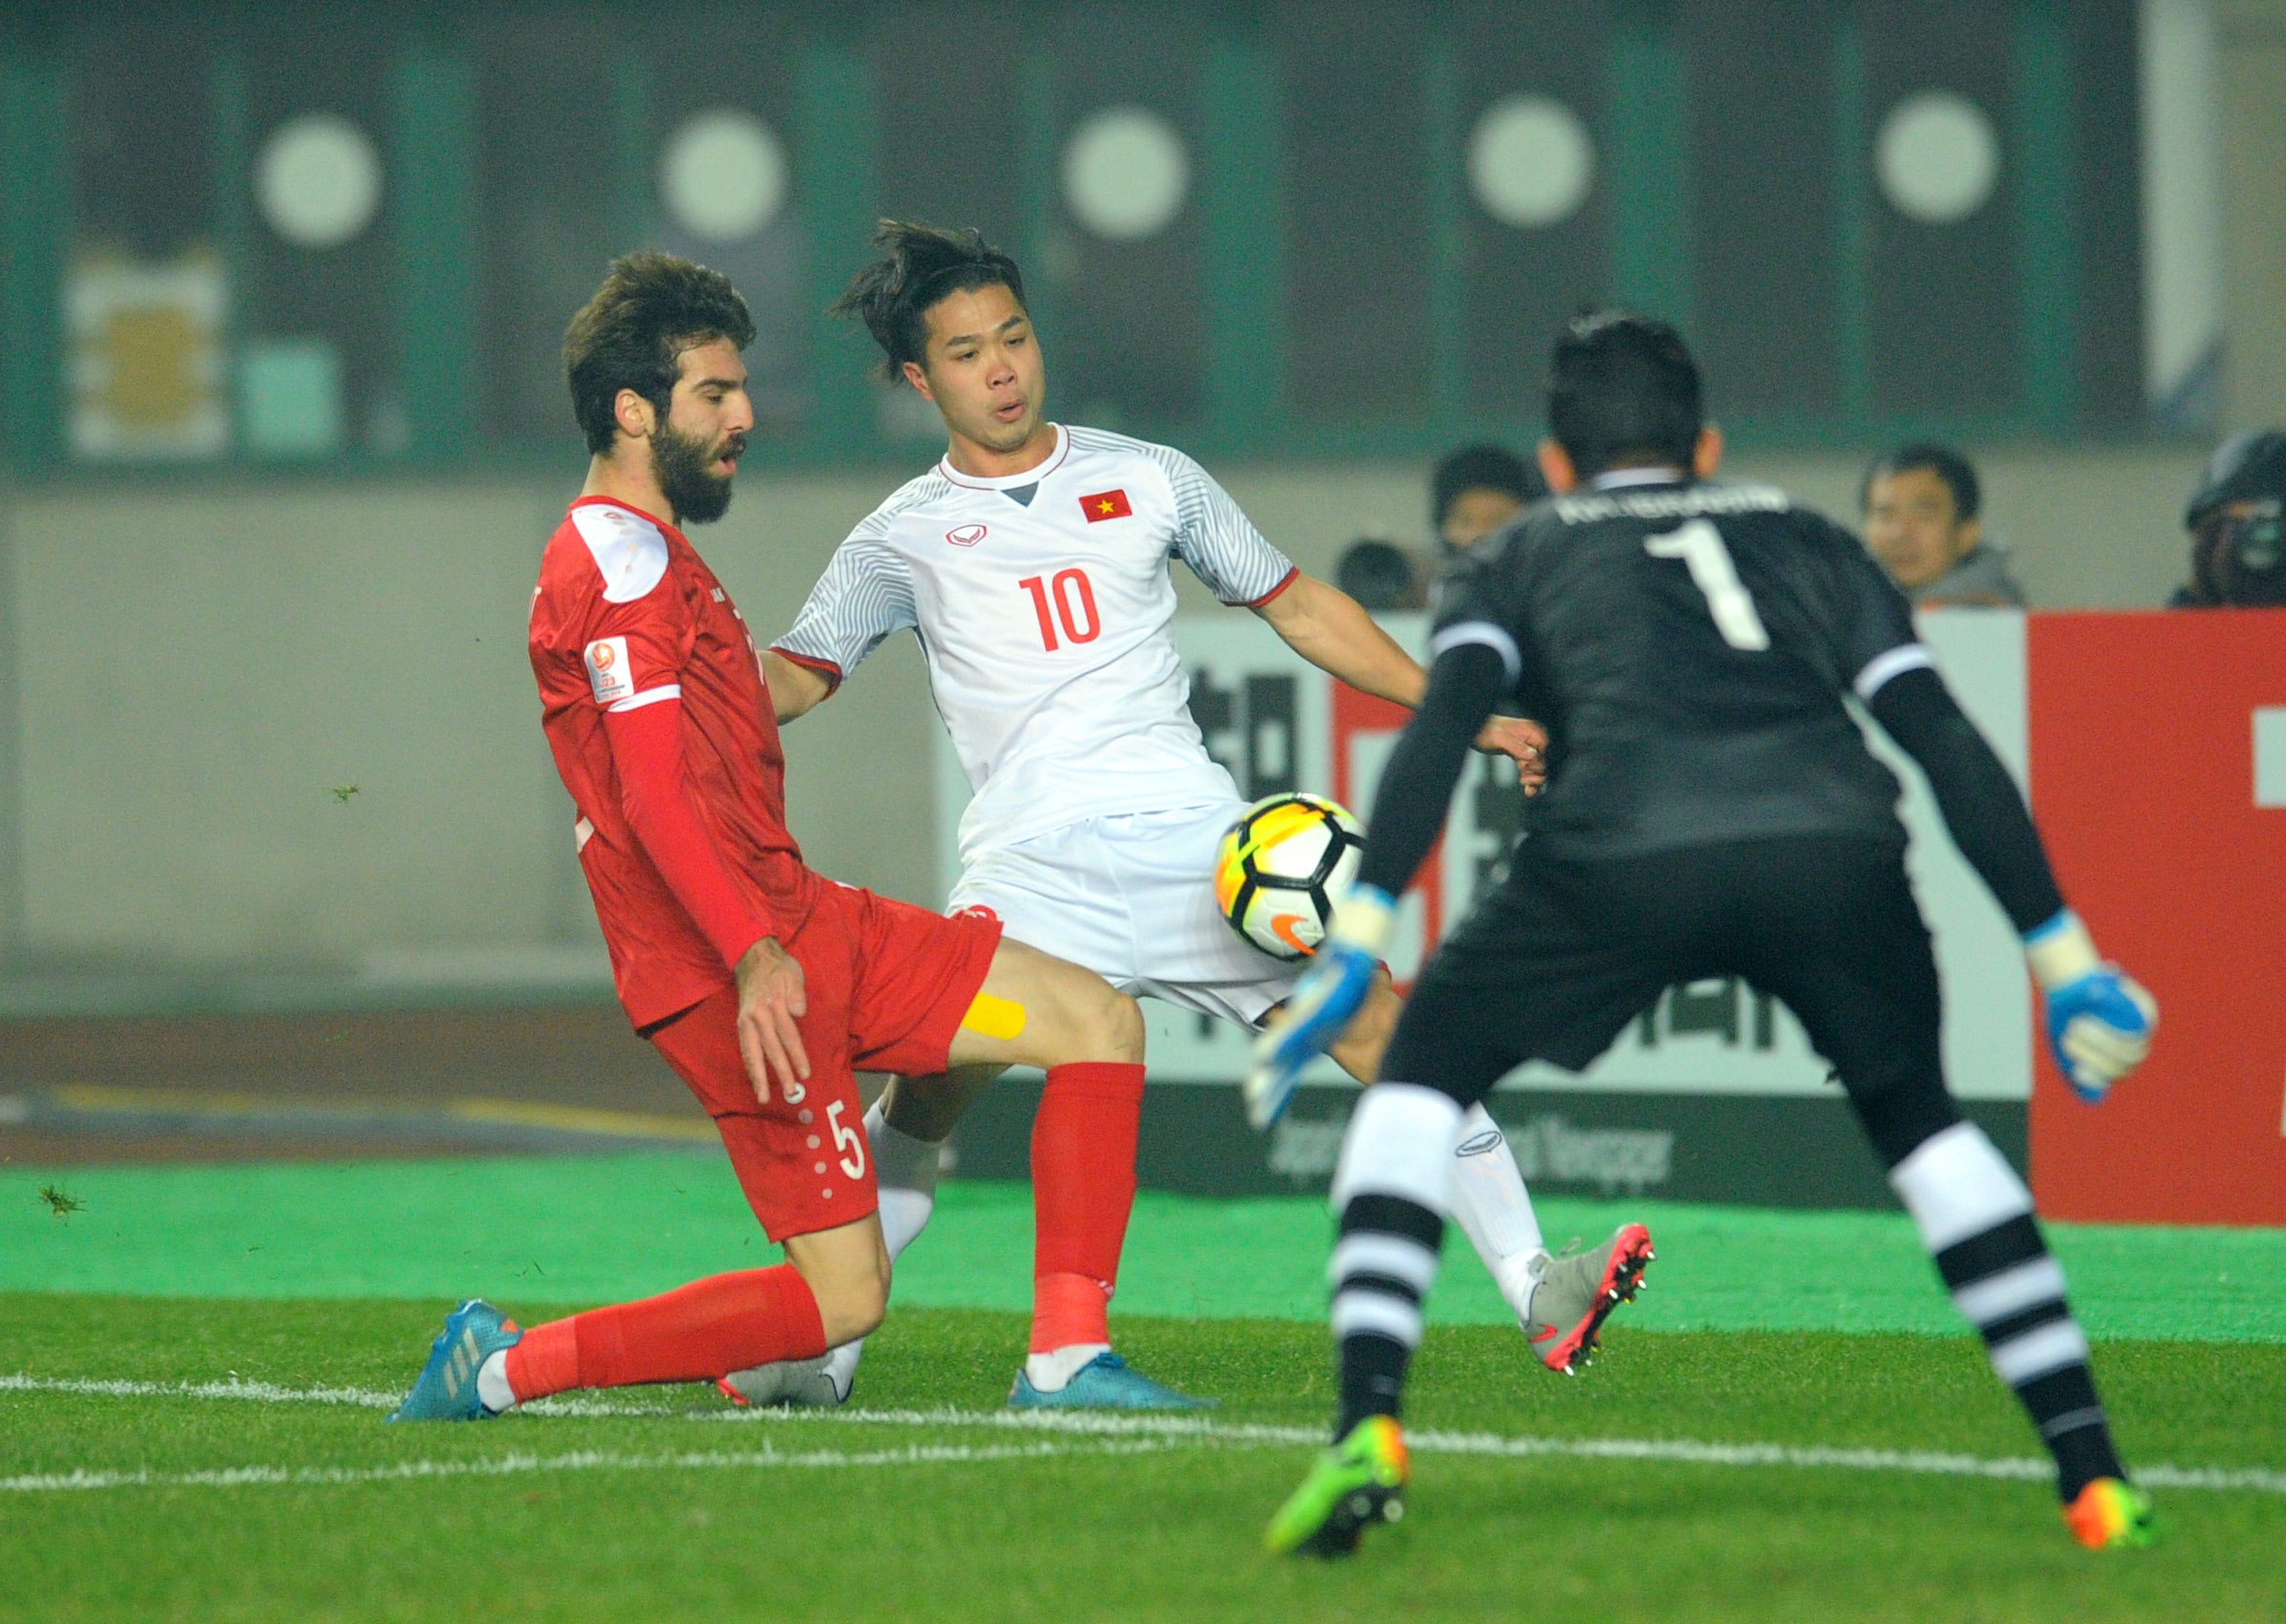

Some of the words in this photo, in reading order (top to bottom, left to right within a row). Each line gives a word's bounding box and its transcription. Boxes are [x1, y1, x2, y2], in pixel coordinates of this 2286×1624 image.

[1018, 567, 1101, 652] 10
[1643, 518, 1771, 652] 1
[826, 1099, 866, 1181] 5
